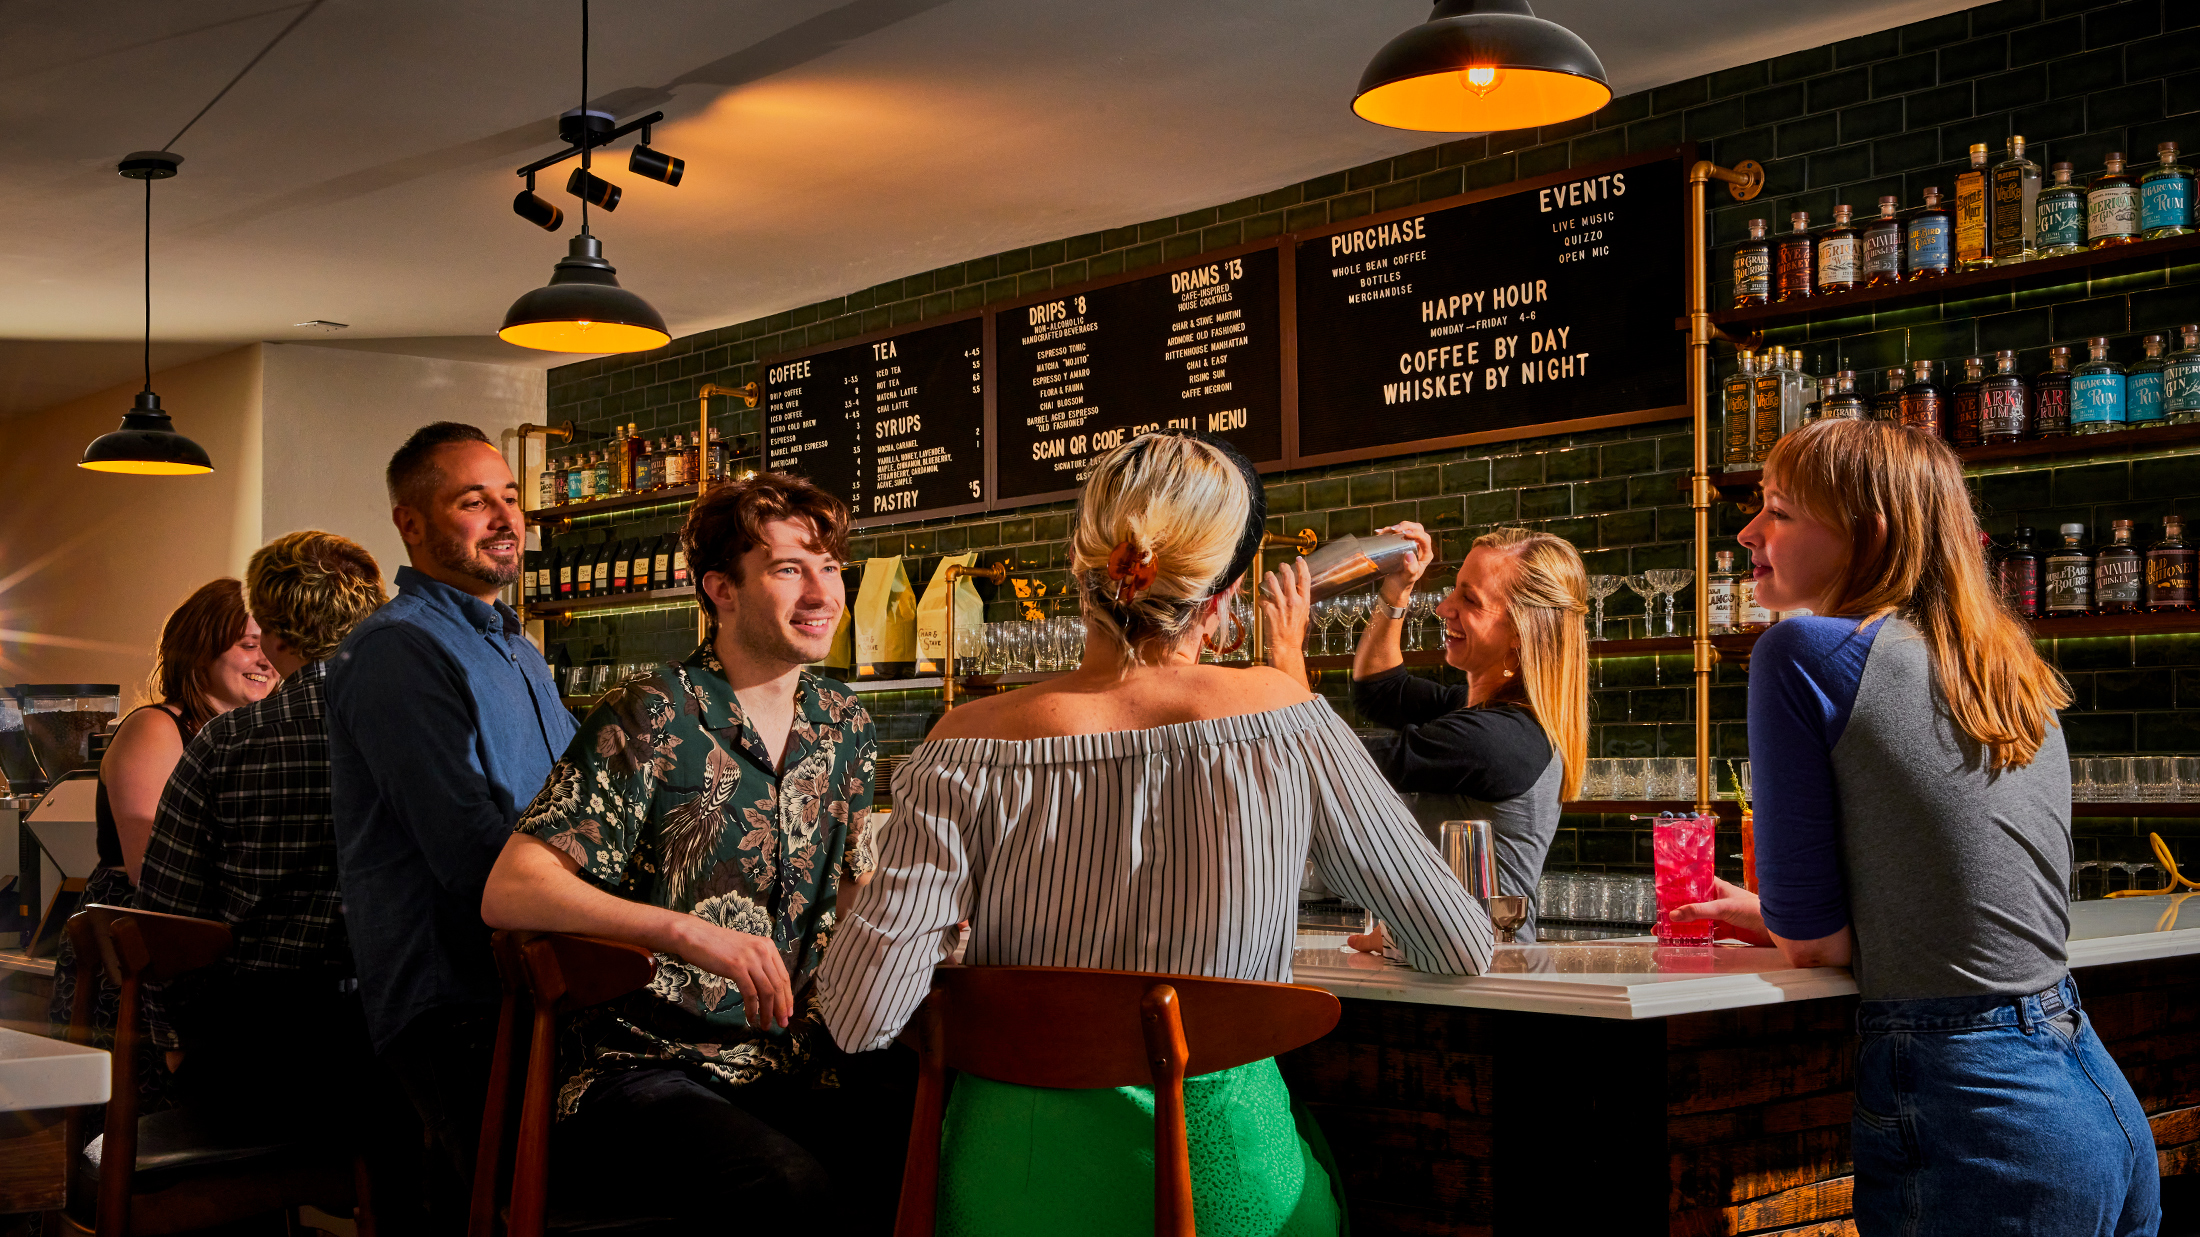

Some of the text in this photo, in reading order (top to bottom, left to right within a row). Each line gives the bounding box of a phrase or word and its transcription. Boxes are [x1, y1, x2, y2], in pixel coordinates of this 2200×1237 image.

[1539, 173, 1626, 213] EVENTS
[2153, 194, 2184, 211] RUM
[1552, 211, 1614, 233] LIVE MUSIC
[2040, 212, 2063, 232] GIN
[1331, 216, 1426, 257] PURCHASE
[1564, 230, 1603, 247] QUIZZO
[1331, 250, 1427, 278] WHOLE BEAN COFFEE
[1558, 245, 1609, 264] OPEN MIC
[1171, 258, 1243, 293] DRAMS $13
[1360, 271, 1401, 288] BOTTLES
[1181, 283, 1230, 301] CAFE-INSPIRED
[1348, 283, 1413, 304] MERCHANDISE
[1422, 279, 1548, 323] HAPPY HOUR
[1029, 295, 1087, 326] DRIPS $8
[1178, 292, 1233, 312] HOUSE COCKTAILS
[1034, 316, 1085, 334] NON-ALCOHOLIC
[1172, 309, 1241, 332] CHAR & STAVE MARTINI
[1430, 310, 1536, 338] MONDAY FRIDAY 4-6
[1022, 322, 1098, 346] HANDCRAFTED BEVERAGES
[1167, 322, 1246, 347] ARDMORE OLD FASHIONED
[872, 340, 897, 361] TEA
[1037, 342, 1086, 360] ESPRESSO TONIC
[1165, 336, 1248, 361] RITTENHOUSE MANHATTAN
[1400, 326, 1570, 375] COFFEE BY DAY
[1036, 361, 1059, 373] MATCHA
[1186, 354, 1228, 370] CHAI & EASY
[769, 360, 811, 385] COFFEE
[876, 368, 888, 378] ICED
[891, 366, 901, 375] TEA
[1032, 368, 1091, 387] ESPRESSO Y AMARO
[1189, 369, 1225, 384] RISING SUN
[1383, 352, 1589, 405] WHISKEY BY NIGHT
[876, 381, 886, 390] HOT
[889, 378, 900, 387] TEA
[876, 391, 897, 401] MATCHA
[900, 386, 918, 397] LATTE
[1040, 382, 1084, 398] FLORA & FAUNA
[1181, 382, 1232, 399] CAFFE NEGRONI
[2166, 377, 2186, 397] GIN
[769, 391, 782, 401] DRIP
[784, 387, 803, 398] COFFEE
[1040, 396, 1084, 411] CHAI BLOSSOM
[2087, 389, 2117, 406] RUM
[770, 399, 799, 412] POUR OVER
[877, 400, 909, 414] CHAI LATTE
[1983, 405, 2010, 420] RUM
[770, 410, 803, 423] ICED COFFEE
[1027, 406, 1099, 426] BARREL AGED ESPRESSO
[770, 425, 786, 434] NITRO
[787, 422, 800, 431] COLD
[802, 419, 816, 429] BREW
[770, 422, 860, 446] ESPRESSO 3
[875, 414, 921, 438] SYRUPS
[1032, 407, 1247, 460] SCAN QR CODE MENU
[896, 439, 919, 450] CARAMEL
[975, 427, 980, 436] 2
[770, 447, 789, 457] BARREL
[790, 445, 802, 454] AGED
[804, 440, 829, 451] ESPRESSO
[770, 457, 798, 468] AMERICANO
[1054, 459, 1087, 471] SIGNATURE
[894, 476, 913, 486] SIMPLE
[873, 480, 980, 513] PASTRY $5
